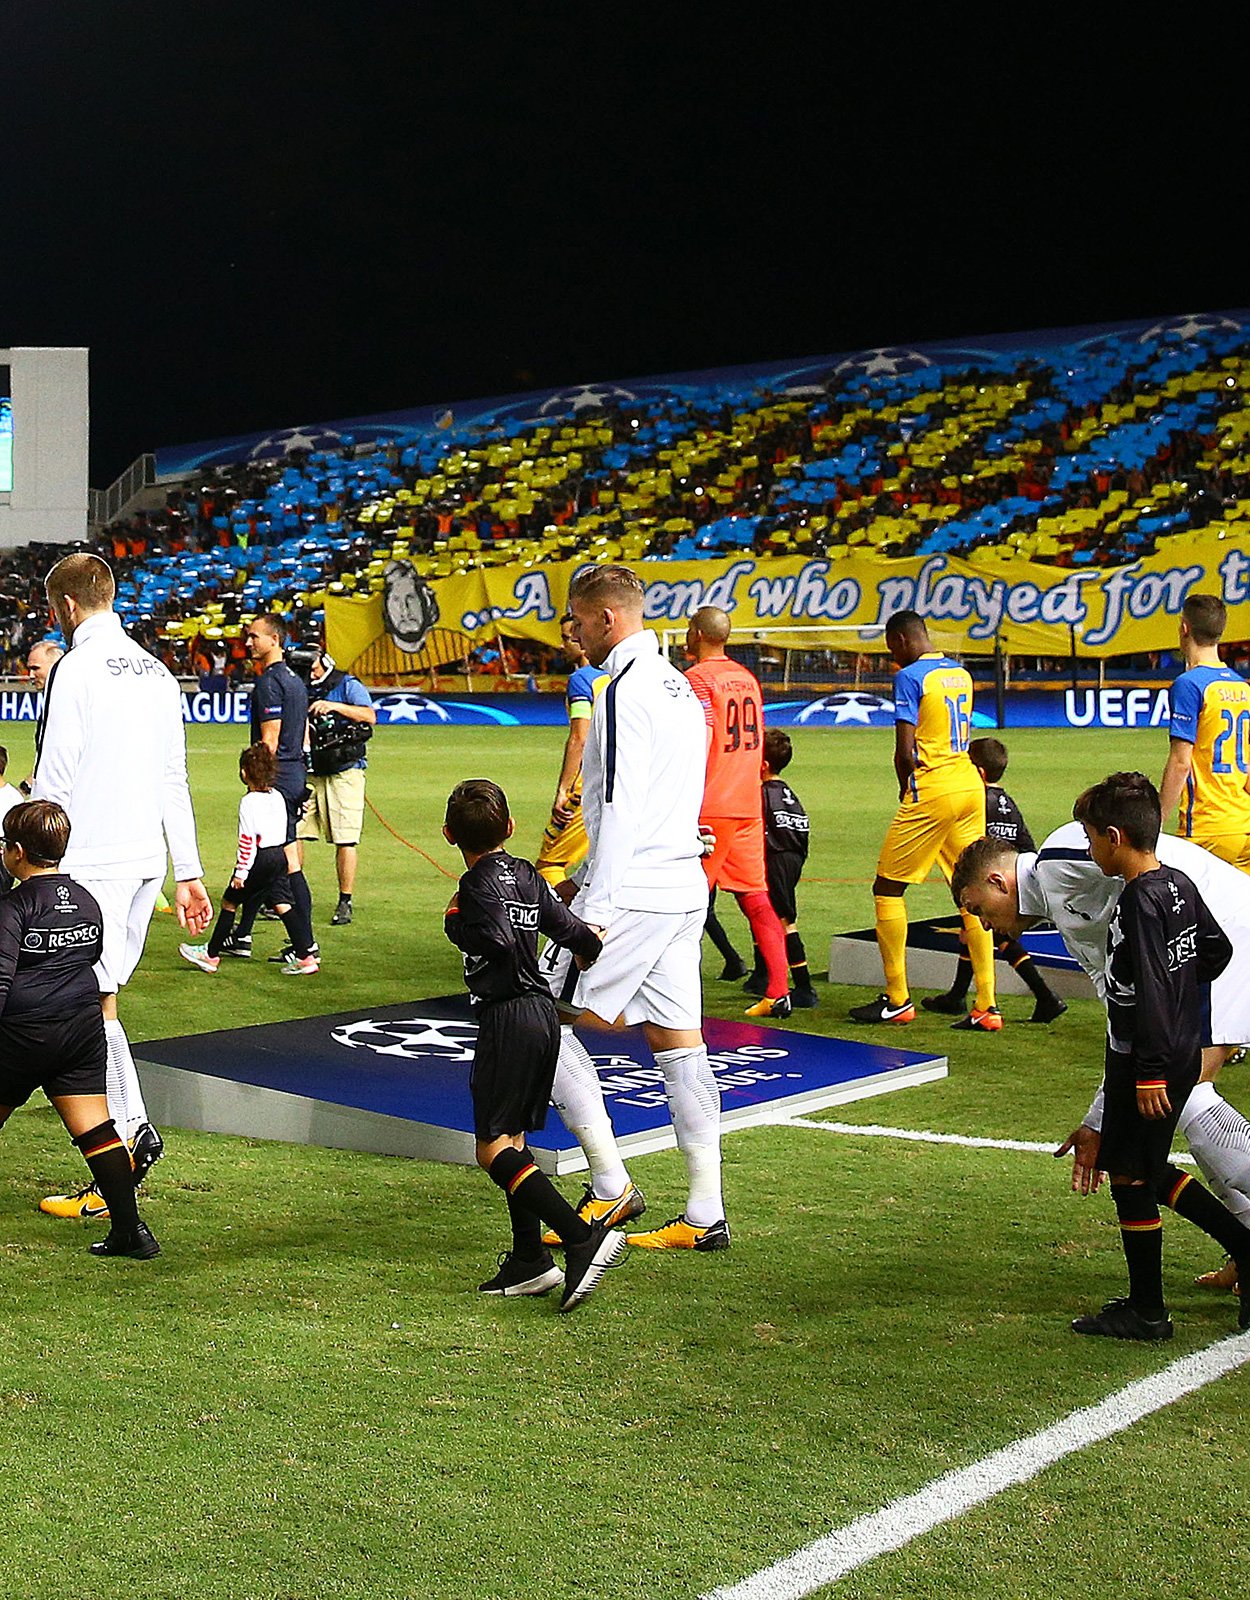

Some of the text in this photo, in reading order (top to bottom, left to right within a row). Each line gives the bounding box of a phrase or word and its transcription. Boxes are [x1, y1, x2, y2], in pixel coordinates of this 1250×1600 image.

[750, 559, 862, 619] who
[859, 554, 1099, 640] played
[1083, 561, 1205, 646] for
[106, 657, 167, 678] SPURS
[180, 692, 248, 723] AGUE
[723, 697, 760, 754] 99
[944, 693, 969, 753] 16
[1065, 688, 1171, 727] UEFA
[1211, 708, 1250, 774] 20
